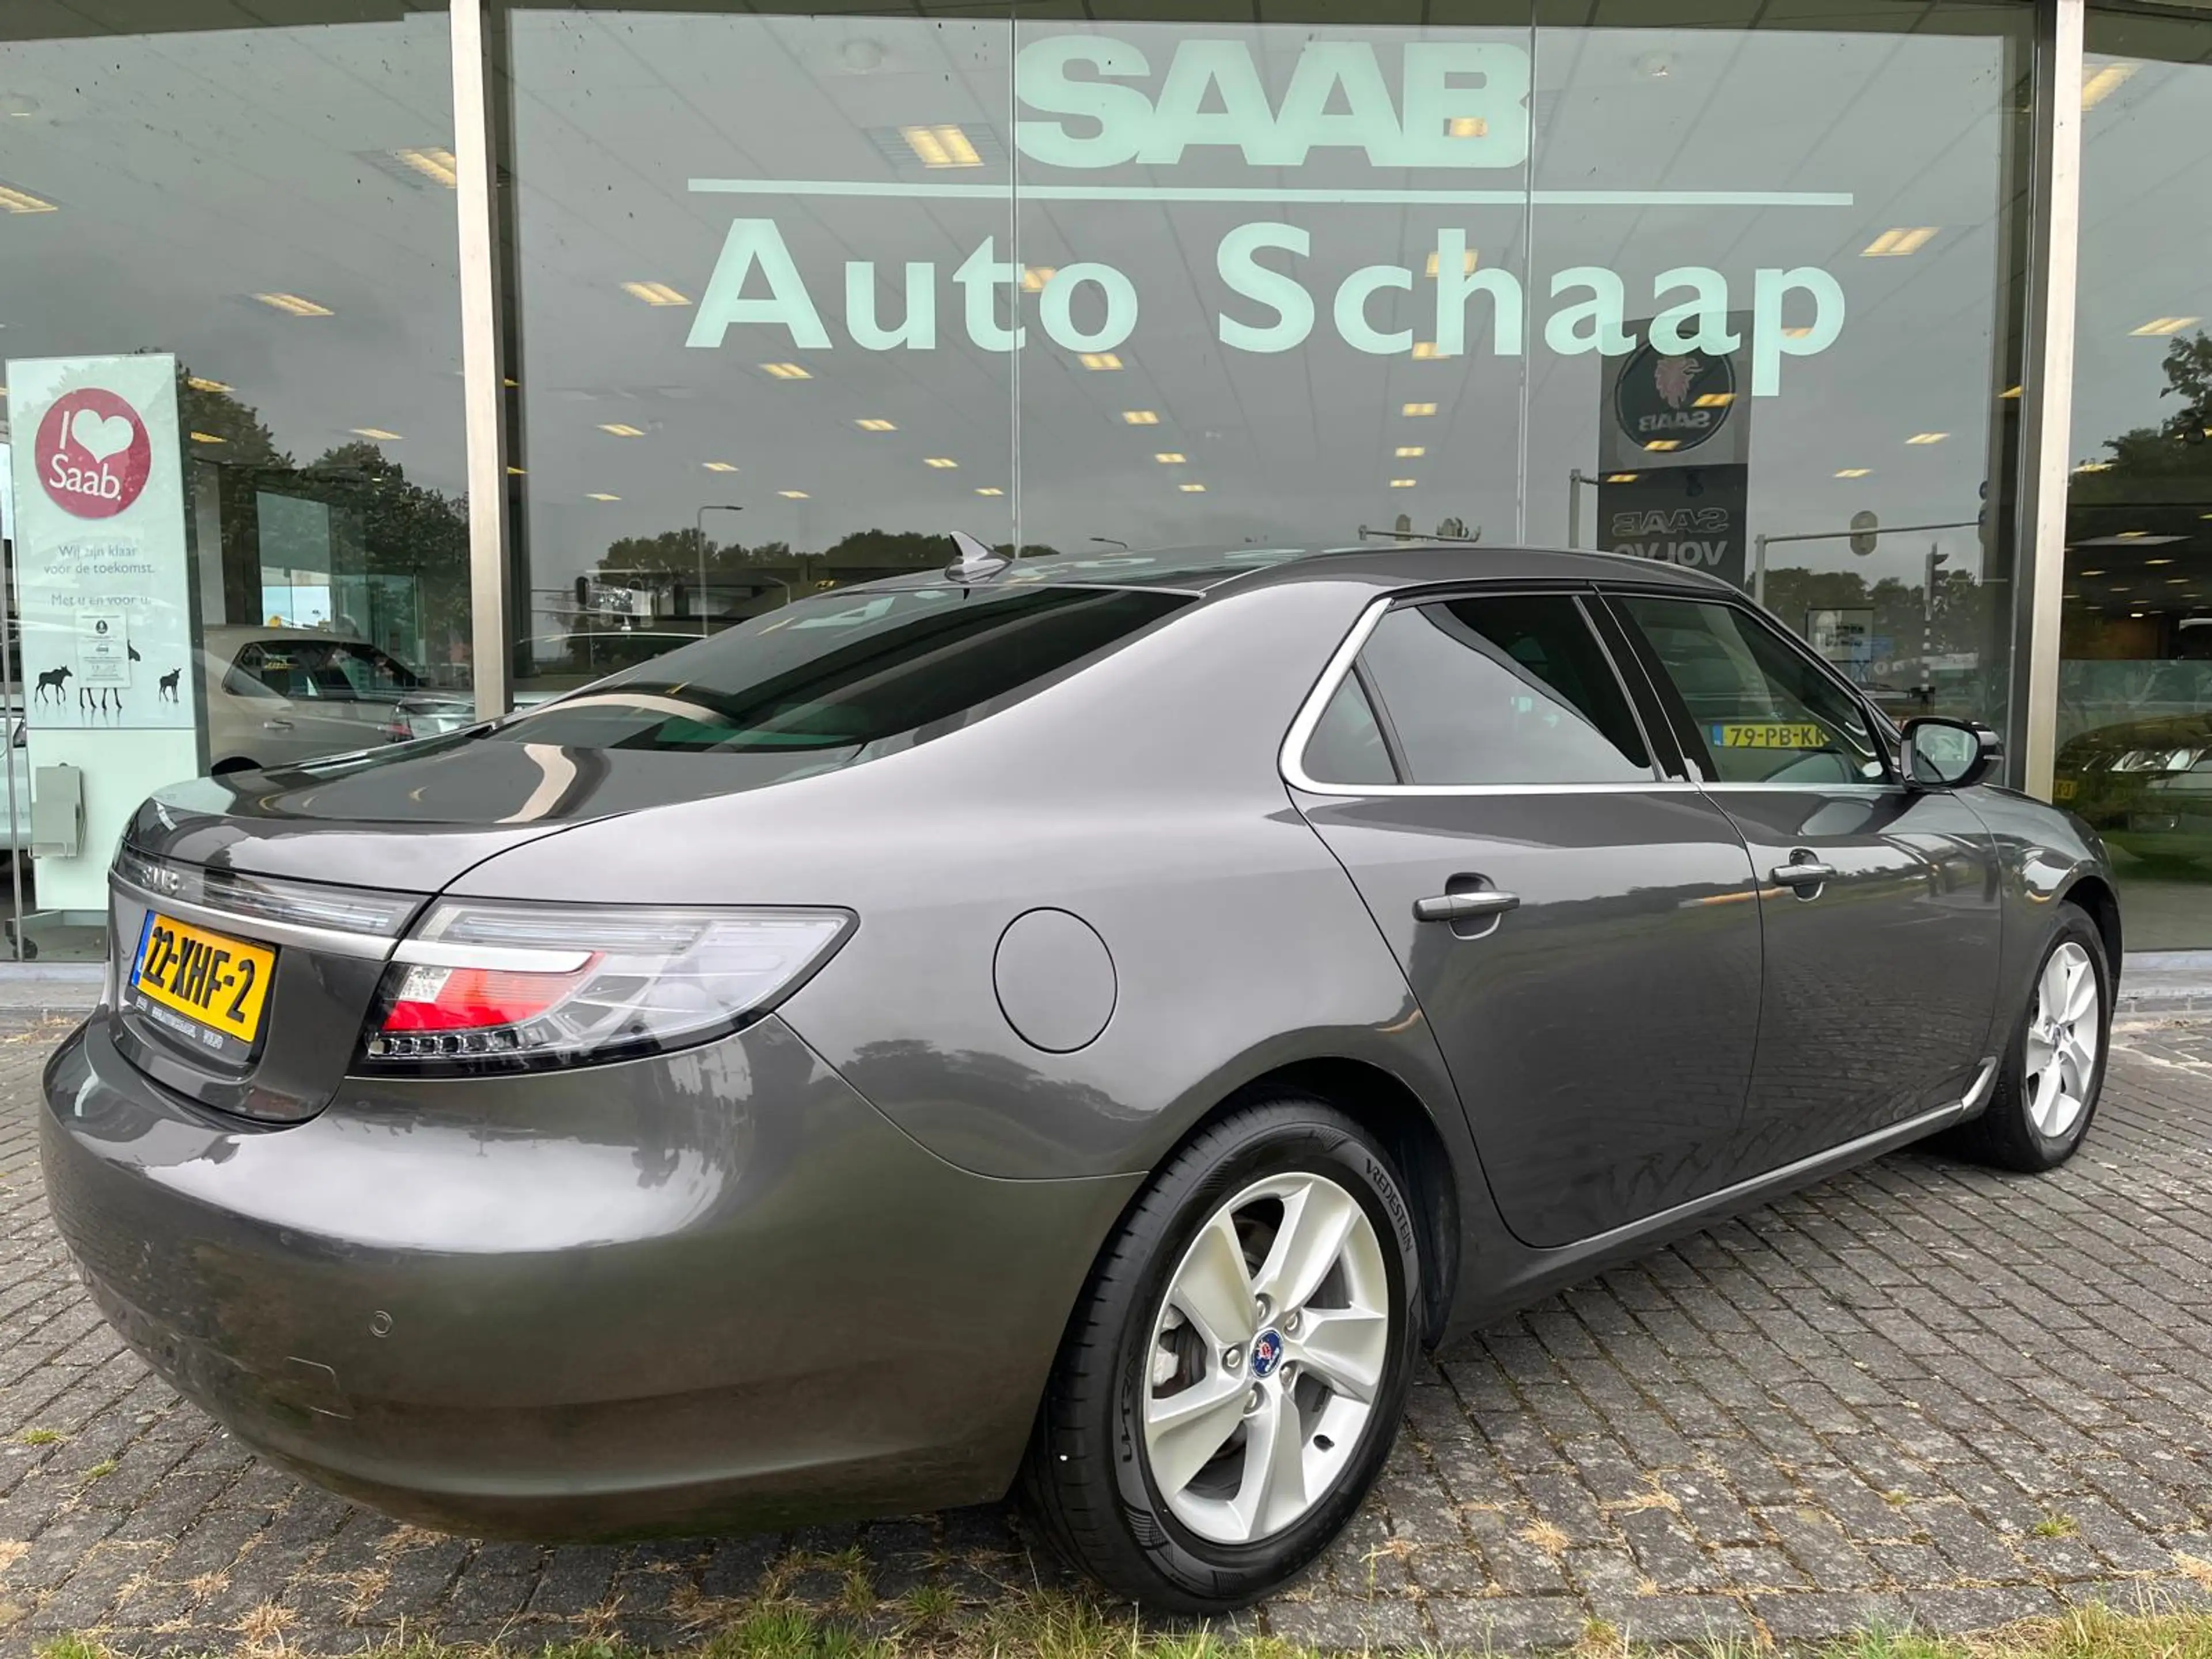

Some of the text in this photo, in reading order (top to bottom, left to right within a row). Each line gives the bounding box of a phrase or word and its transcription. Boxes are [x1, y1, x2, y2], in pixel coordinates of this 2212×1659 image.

[1016, 35, 1531, 168] SAAB
[685, 218, 1846, 396] Auto Schaap
[59, 410, 70, 450] I
[50, 453, 122, 501] Saab.
[44, 561, 155, 574] voor de toekomst.
[58, 546, 80, 560] Wij
[108, 544, 137, 557] klaar
[51, 593, 74, 606] Met
[107, 596, 138, 606] voor
[143, 926, 255, 1024] 22-XHF-2
[1365, 1158, 1413, 1252] VREDESTEIN
